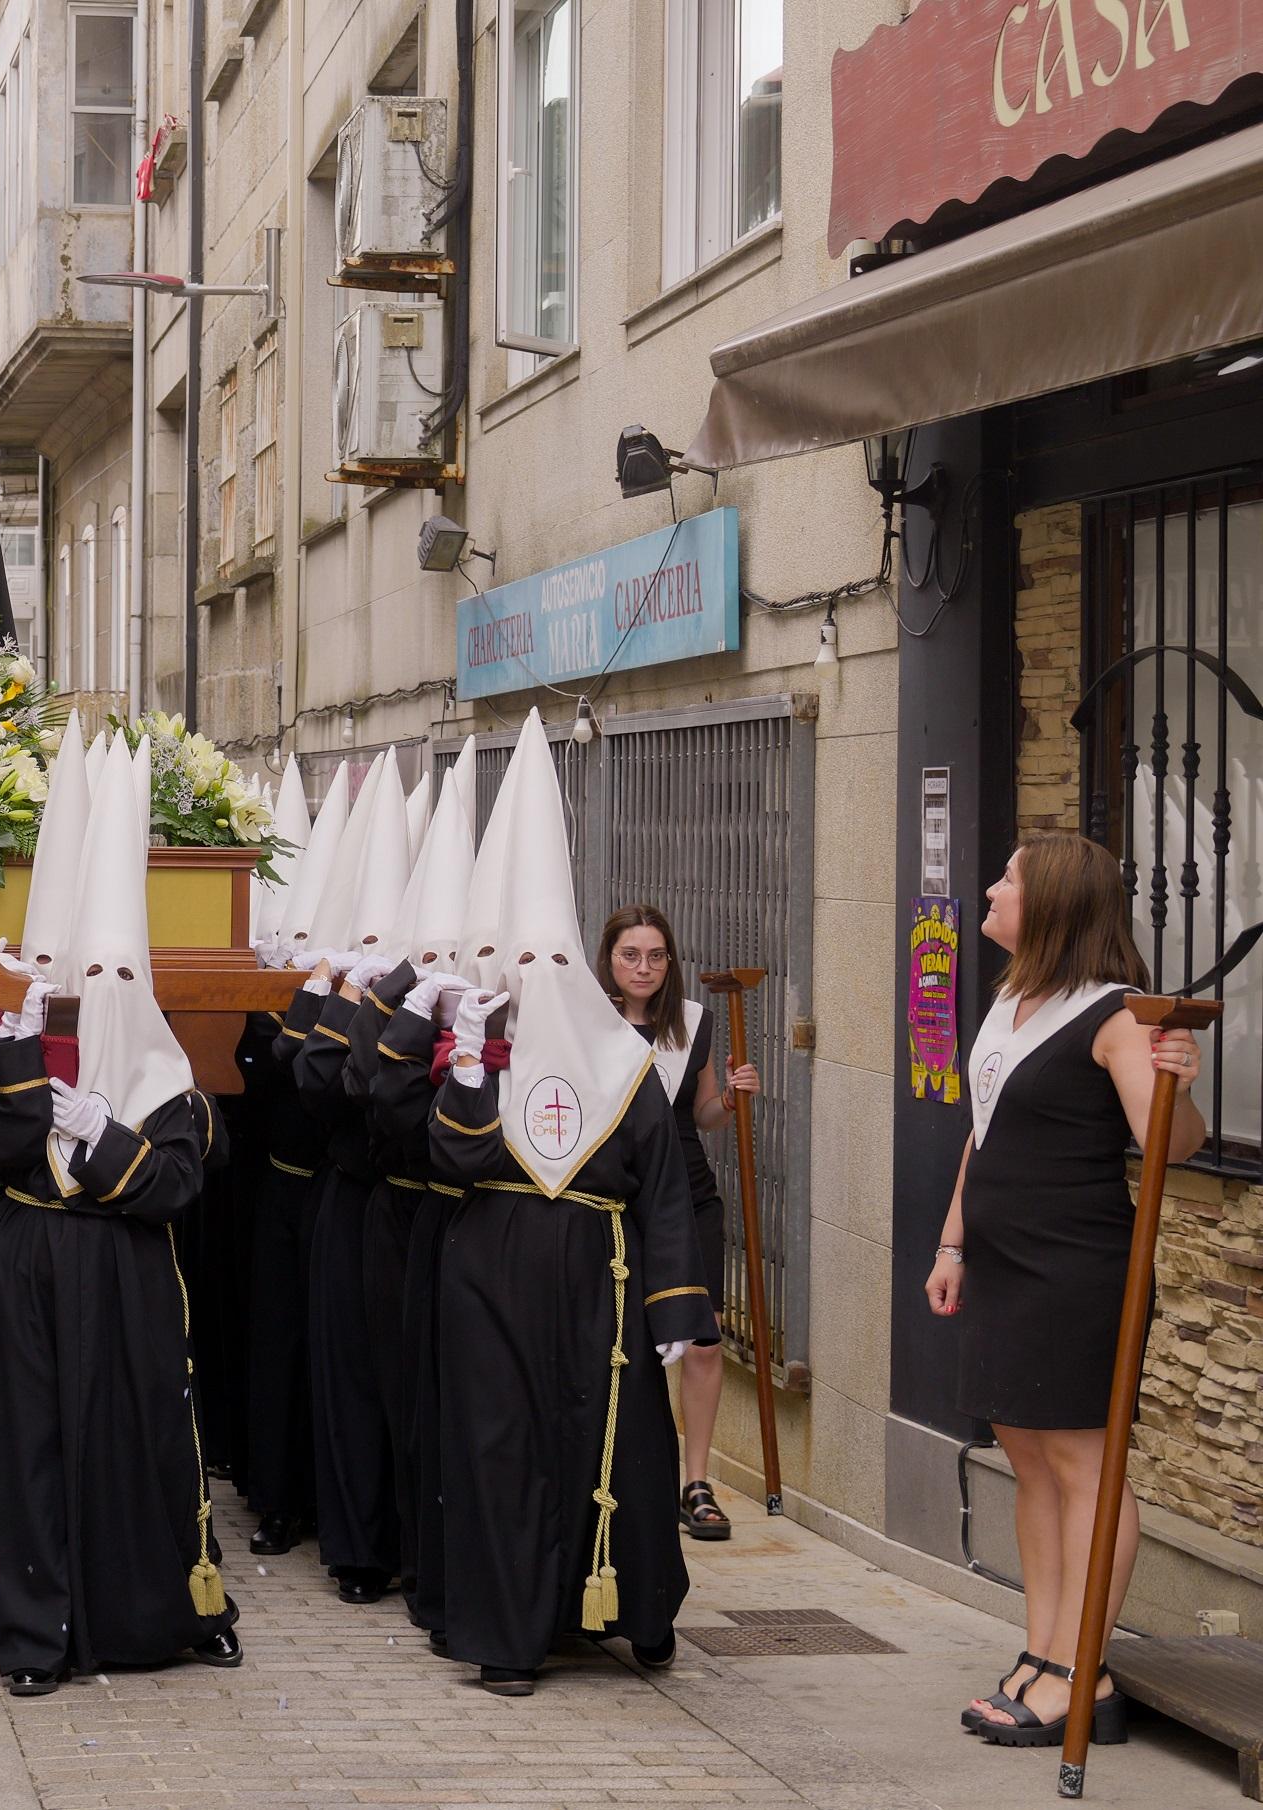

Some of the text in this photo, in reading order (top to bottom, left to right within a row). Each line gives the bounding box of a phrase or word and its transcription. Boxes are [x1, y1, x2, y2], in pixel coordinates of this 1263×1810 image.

[993, 0, 1191, 128] CASA
[542, 560, 605, 614] AUTOSERVICIO
[614, 560, 703, 632] CARNICERIA
[467, 611, 534, 668] CHARCUTERIA
[548, 611, 600, 676] MARIA
[920, 947, 951, 974] VERÁN
[533, 1110, 568, 1123] Santo
[533, 1124, 568, 1137] Cristo
